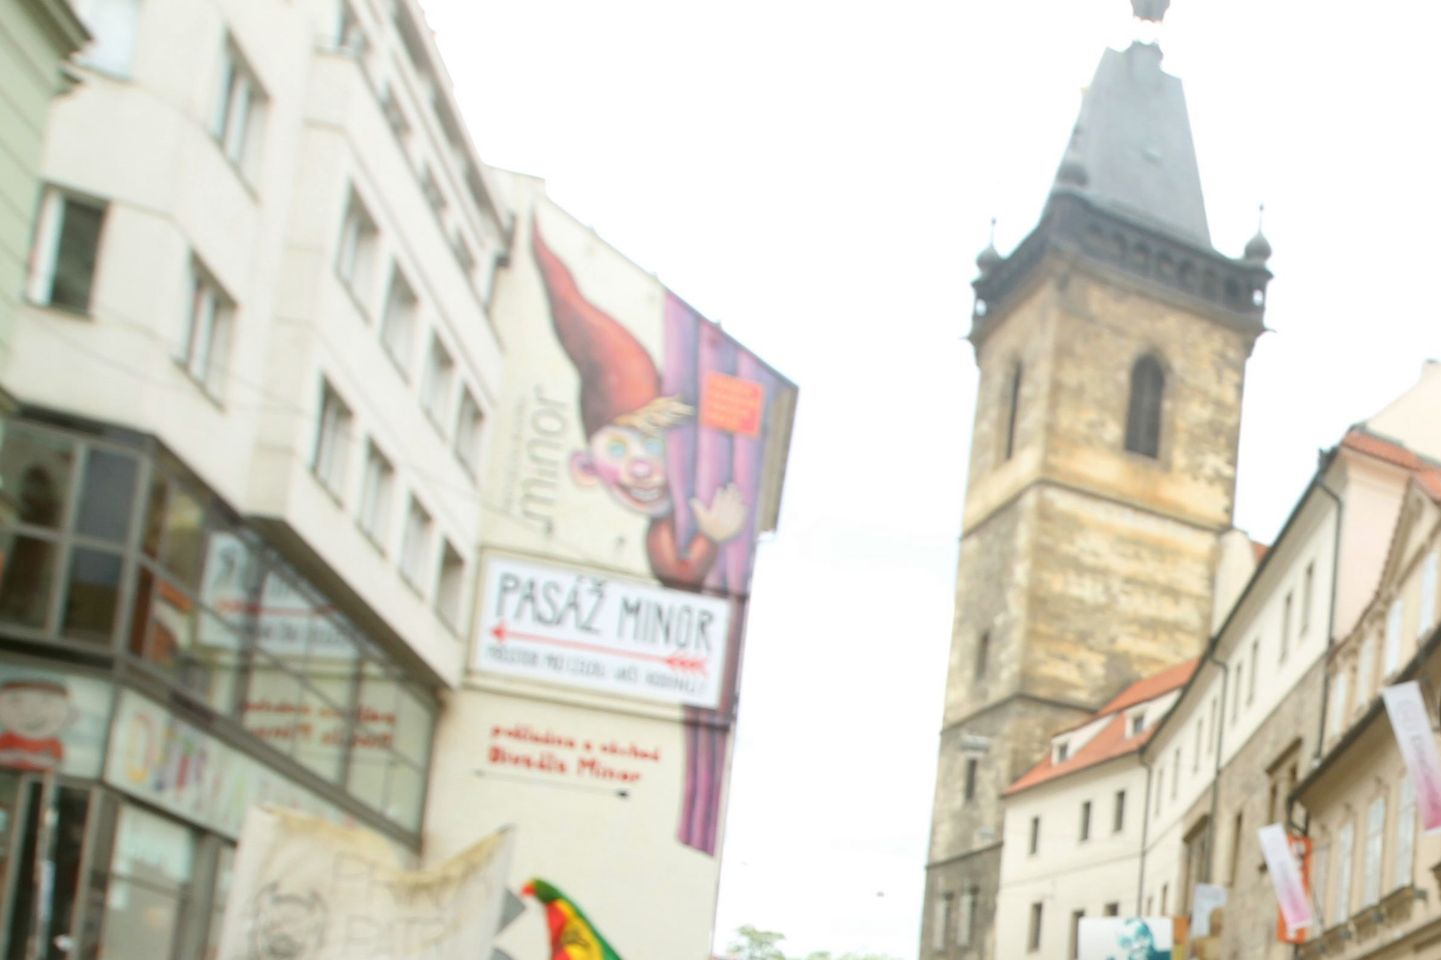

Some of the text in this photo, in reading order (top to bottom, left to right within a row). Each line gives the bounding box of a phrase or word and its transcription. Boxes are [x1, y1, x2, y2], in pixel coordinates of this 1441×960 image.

[495, 571, 715, 653] PASÁŽ MINOR
[577, 756, 642, 783] Minor
